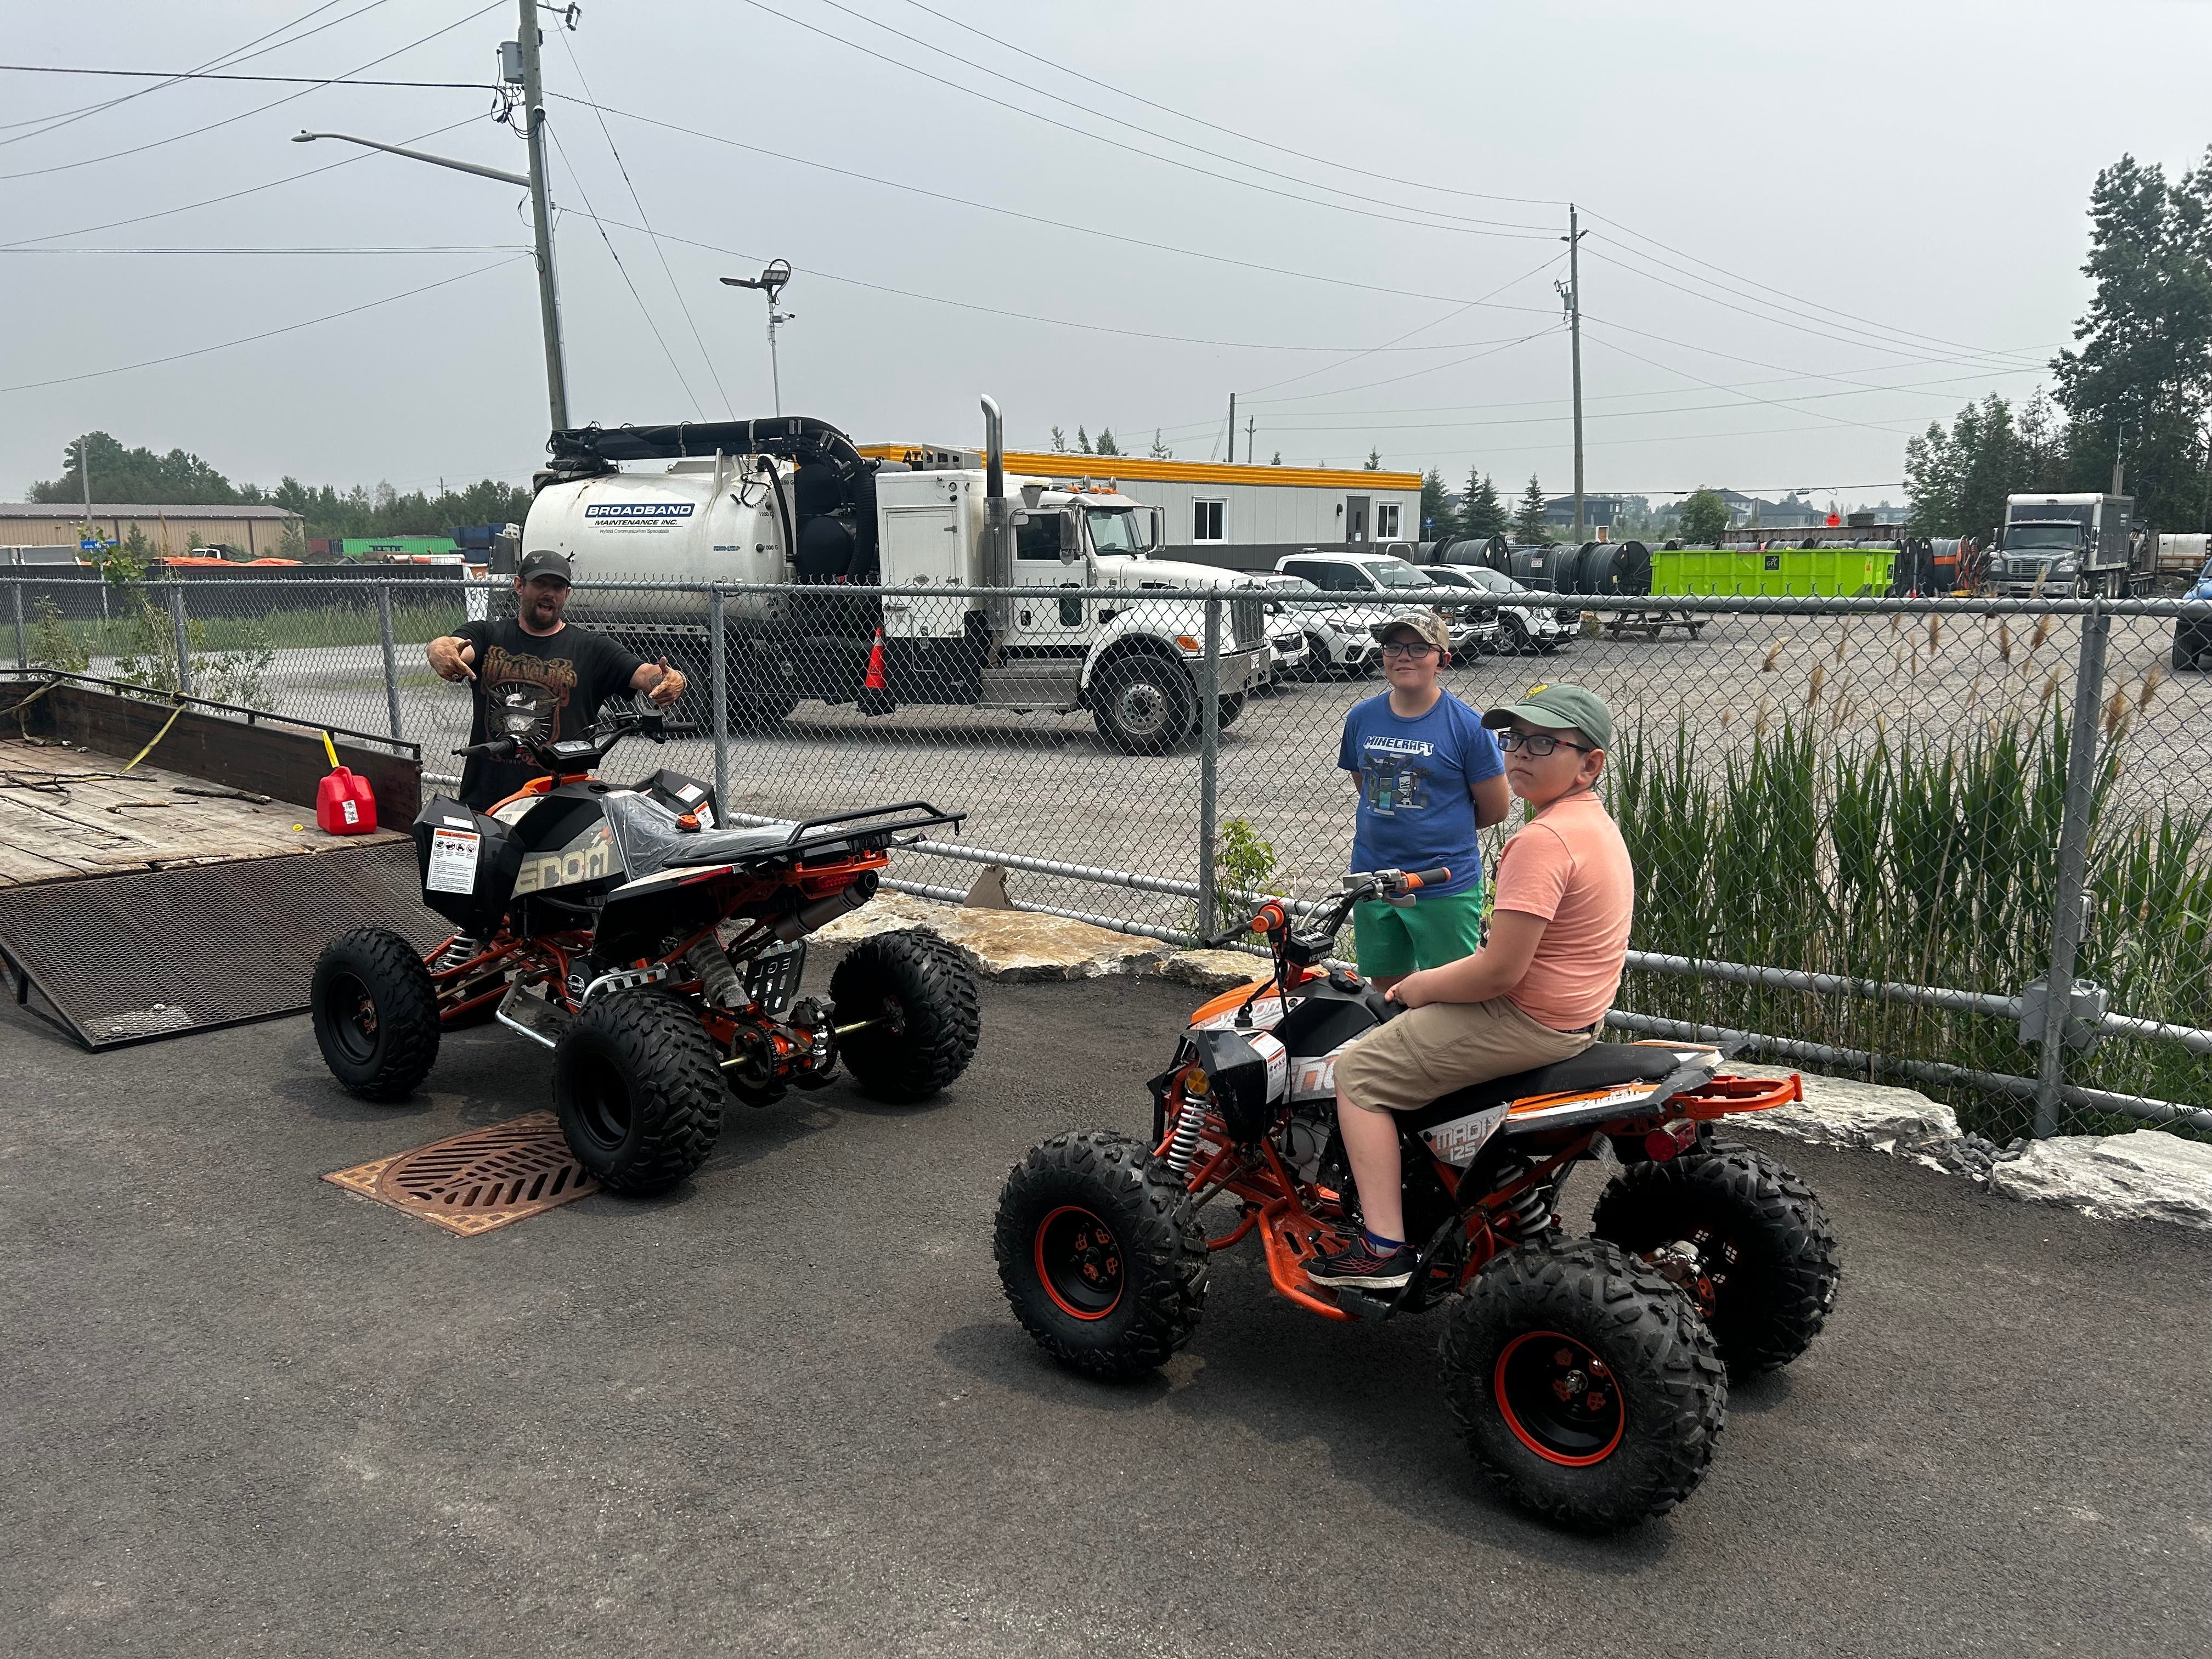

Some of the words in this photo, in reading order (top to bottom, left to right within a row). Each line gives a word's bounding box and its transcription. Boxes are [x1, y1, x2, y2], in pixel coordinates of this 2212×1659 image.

[587, 505, 692, 516] BROADBAND
[1363, 736, 1434, 755] MINECRAFT
[1219, 1001, 1283, 1028] VEOM
[1450, 1142, 1476, 1162] 125
